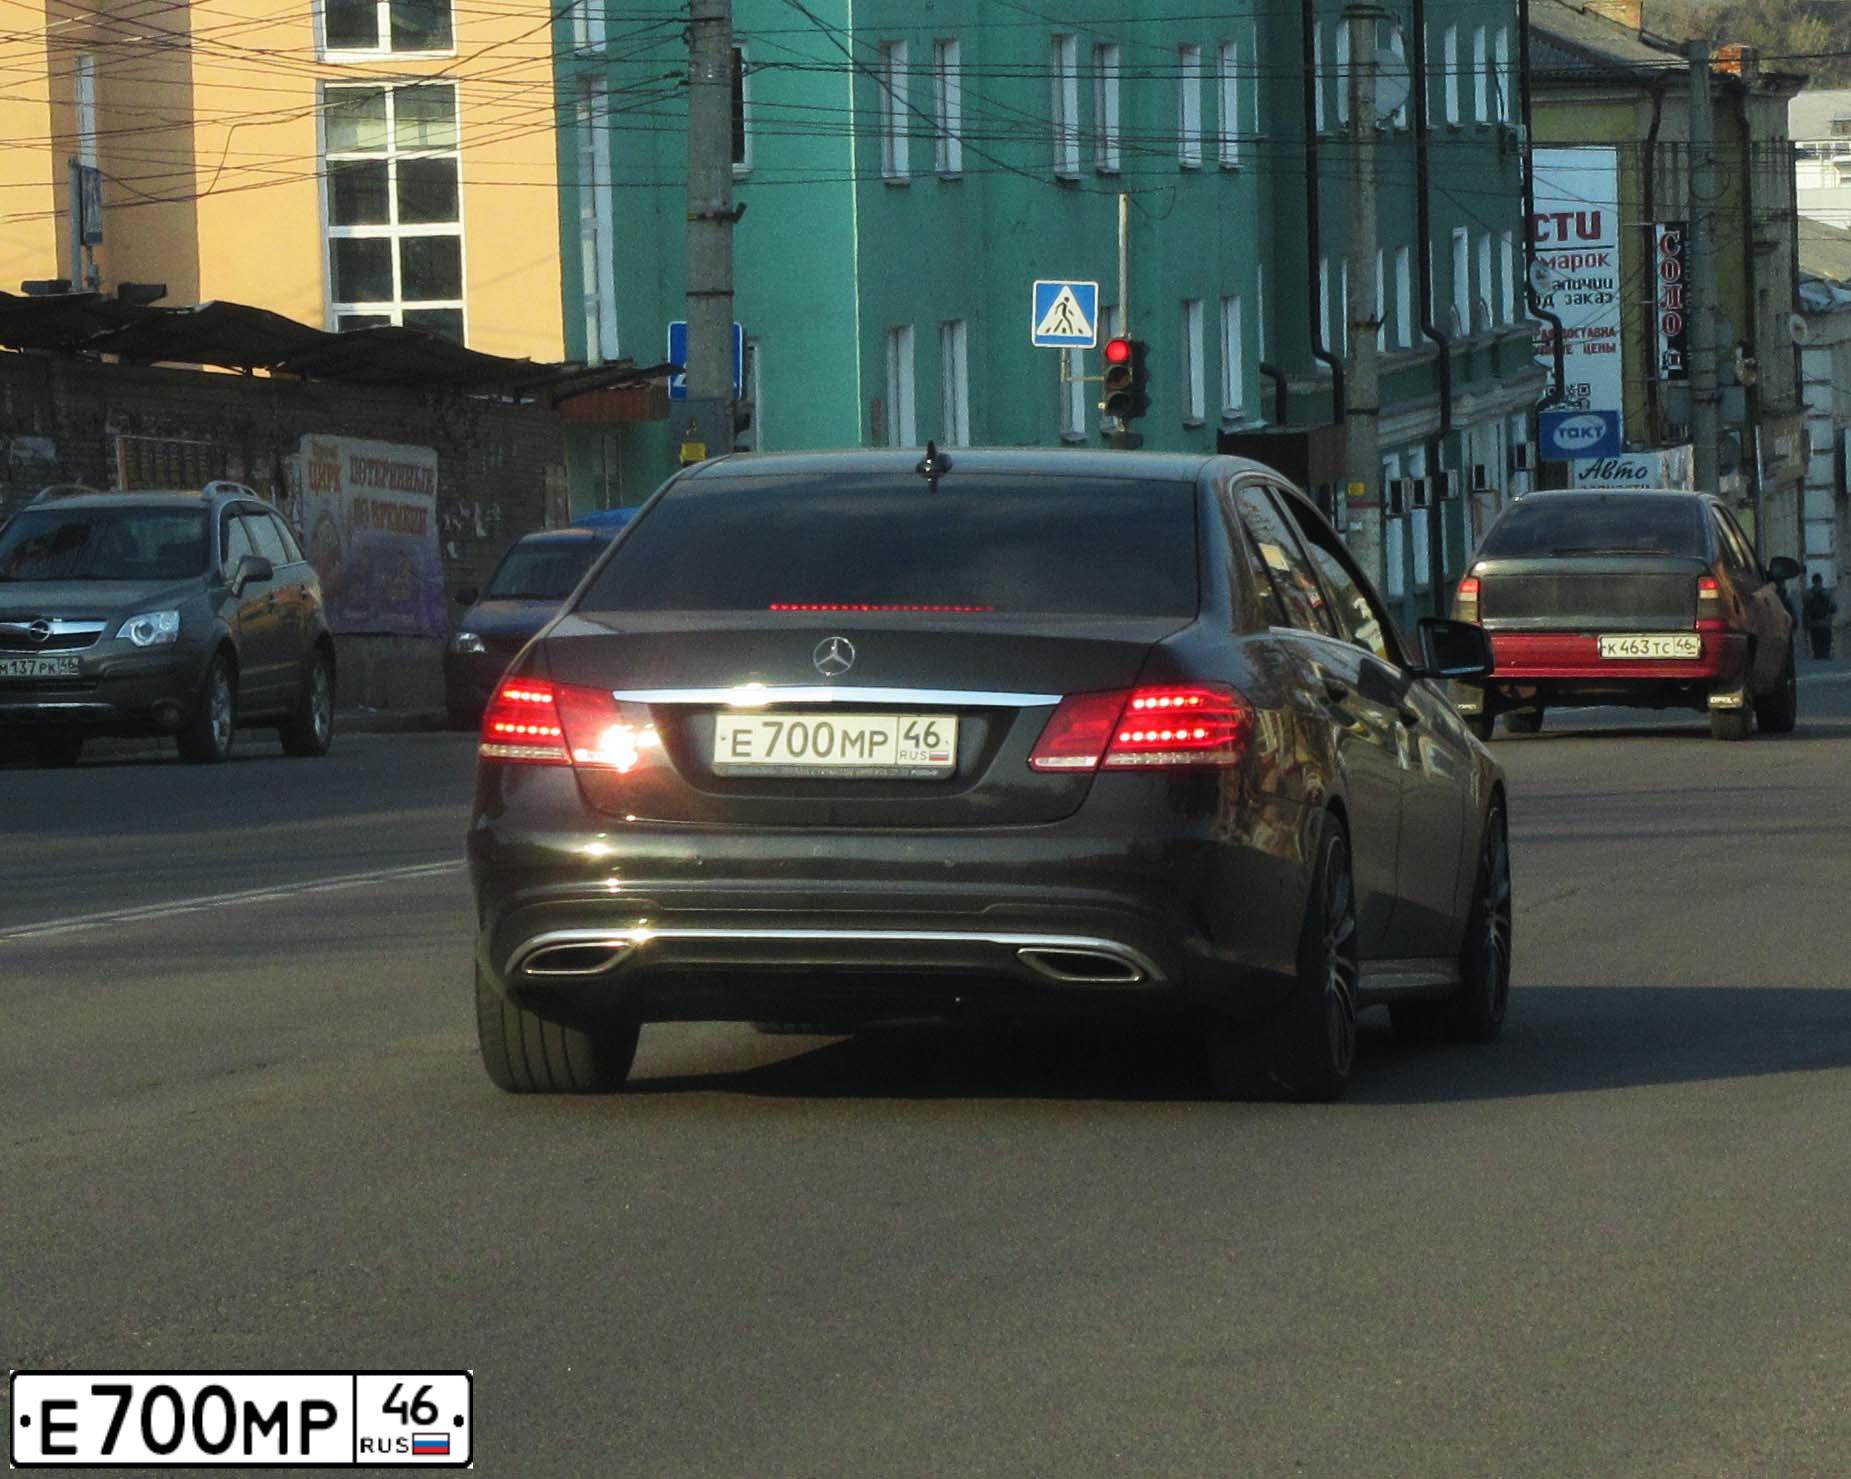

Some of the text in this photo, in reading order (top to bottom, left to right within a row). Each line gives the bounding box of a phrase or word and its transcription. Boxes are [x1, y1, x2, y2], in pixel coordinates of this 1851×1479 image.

[1551, 277, 1613, 291] аличии
[1660, 230, 1682, 336] СОЛО
[1563, 291, 1612, 305] заказ
[1578, 457, 1648, 480] Авто
[1608, 638, 1692, 655] К463ТС 46
[732, 720, 941, 758] Е700МР 46
[900, 751, 927, 760] RUS
